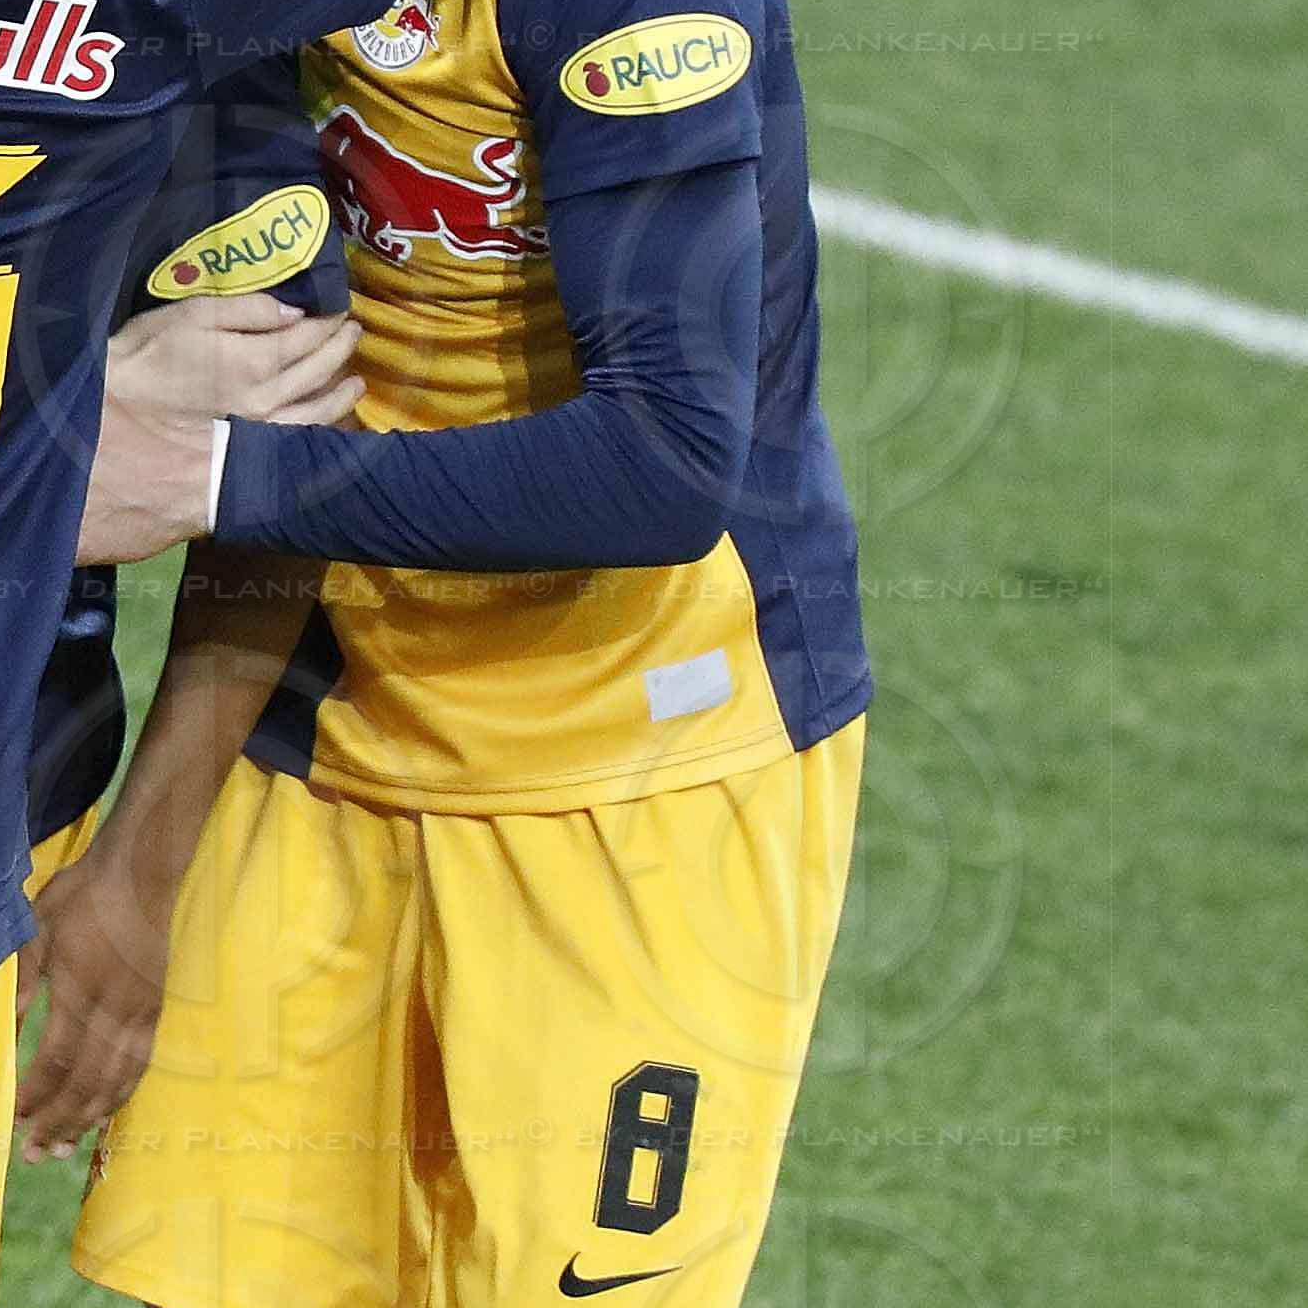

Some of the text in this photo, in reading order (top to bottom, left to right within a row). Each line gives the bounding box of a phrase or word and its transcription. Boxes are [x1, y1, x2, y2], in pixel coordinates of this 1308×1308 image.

[611, 32, 732, 91] RAUCH
[198, 200, 312, 276] RAUCH
[593, 1060, 700, 1235] 8
